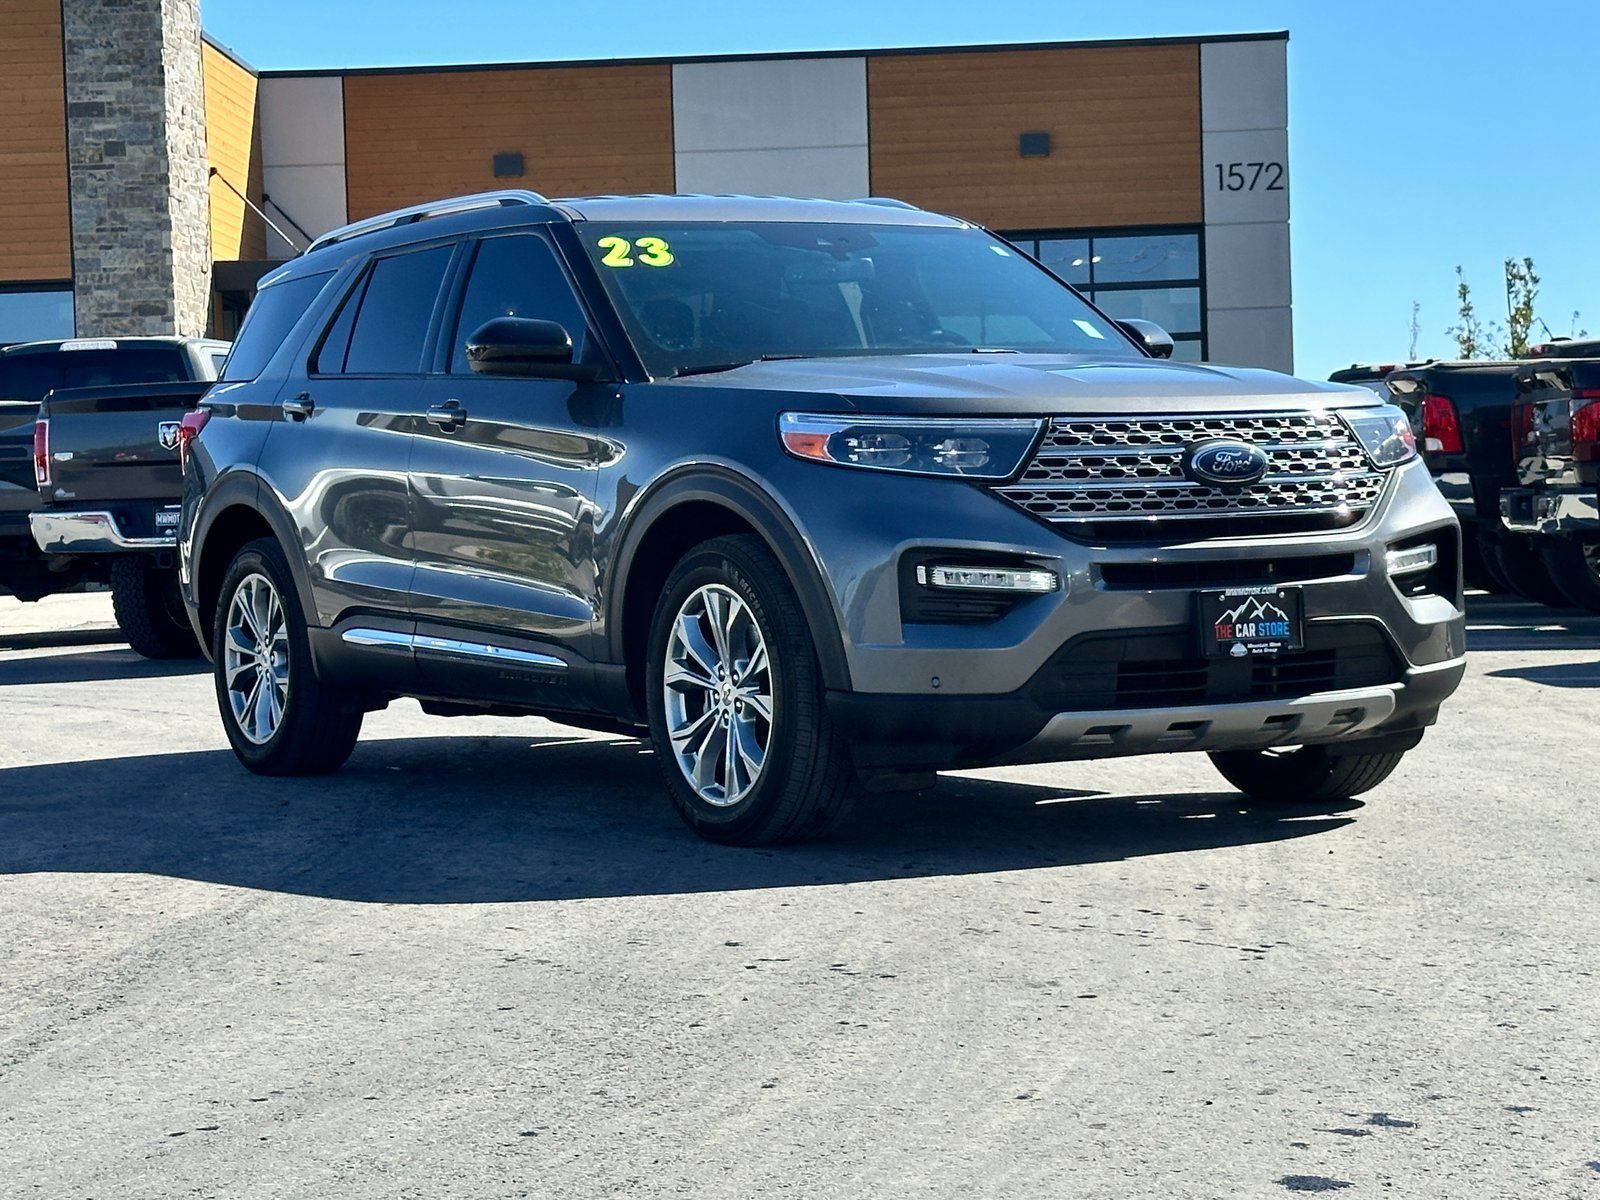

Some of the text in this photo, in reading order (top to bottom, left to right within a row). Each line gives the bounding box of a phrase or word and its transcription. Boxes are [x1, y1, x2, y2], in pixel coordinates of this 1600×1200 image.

[1215, 162, 1284, 191] 1572
[597, 236, 675, 268] 23
[1212, 451, 1253, 473] Ford
[1215, 622, 1289, 639] THE CAR STORE
